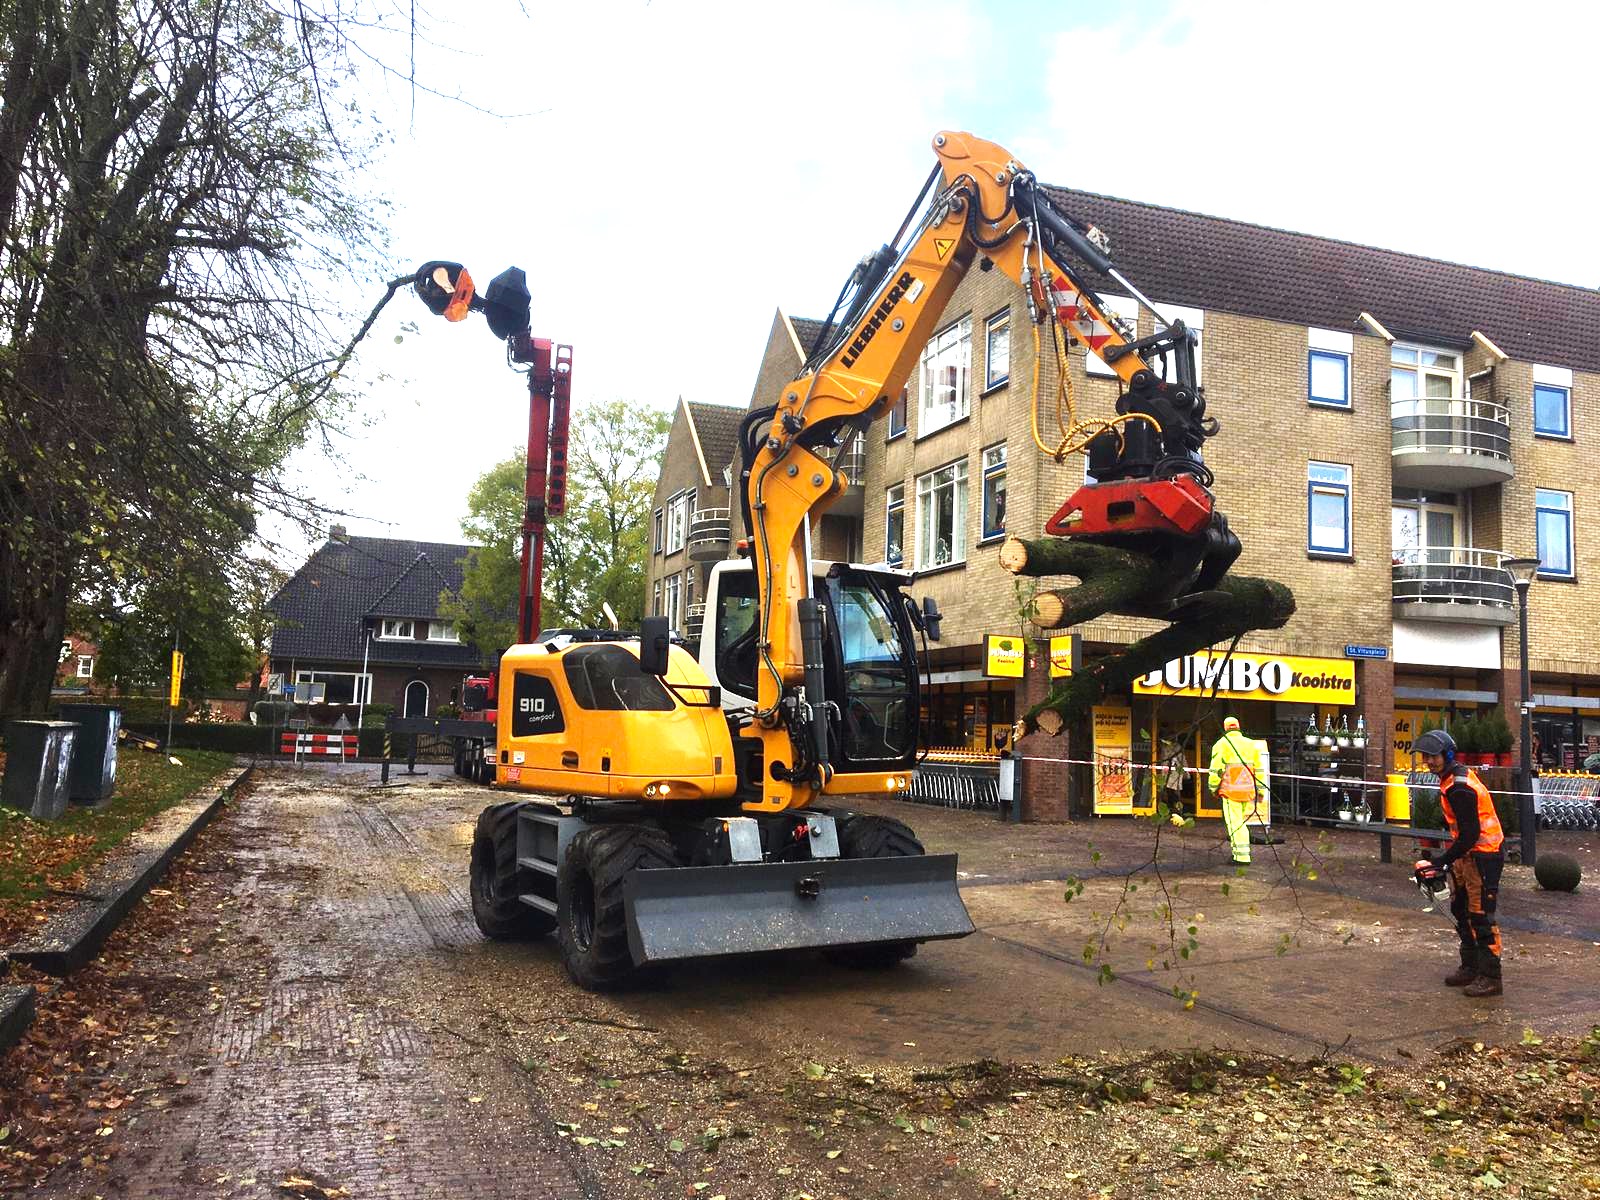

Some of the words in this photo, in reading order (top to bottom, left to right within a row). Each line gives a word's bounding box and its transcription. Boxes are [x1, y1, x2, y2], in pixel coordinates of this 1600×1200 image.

[840, 271, 917, 370] LIEBHERR
[1290, 671, 1352, 690] Kooistra
[520, 697, 545, 712] 910
[529, 710, 555, 724] compact
